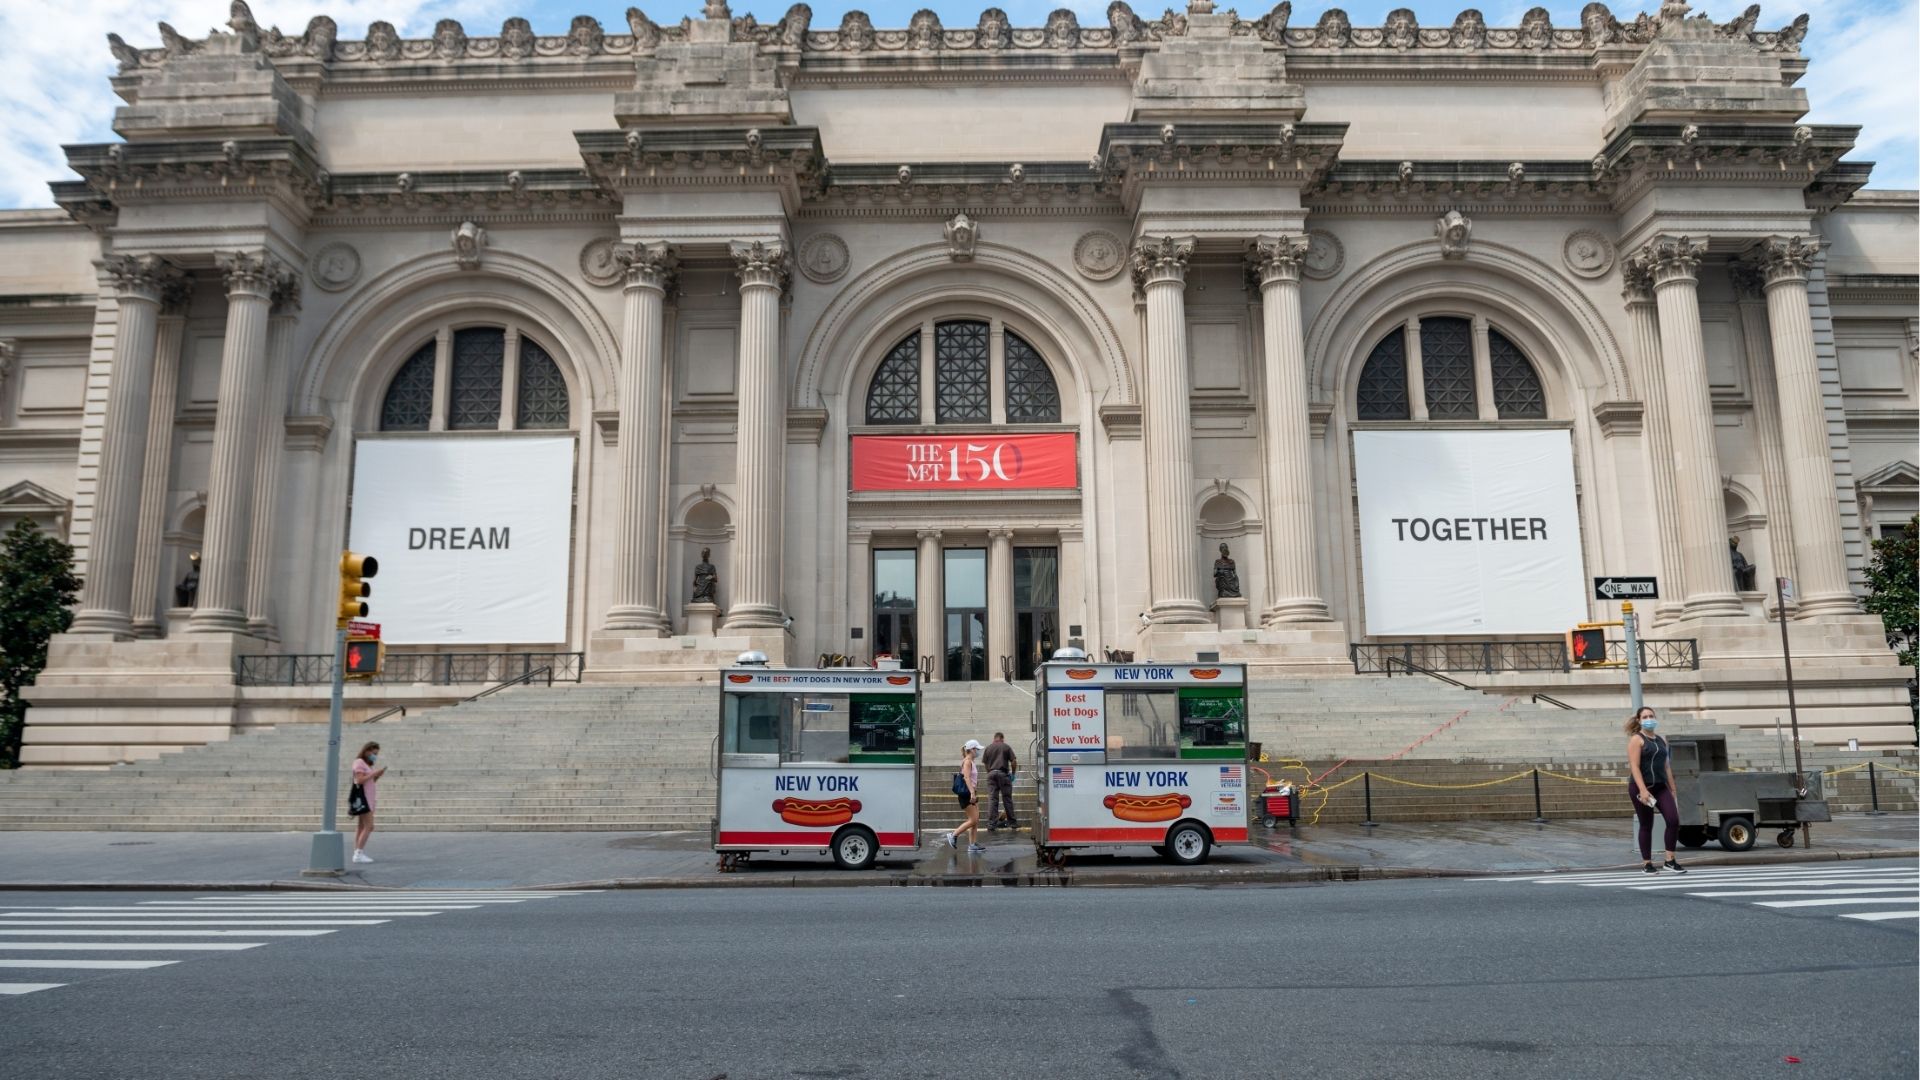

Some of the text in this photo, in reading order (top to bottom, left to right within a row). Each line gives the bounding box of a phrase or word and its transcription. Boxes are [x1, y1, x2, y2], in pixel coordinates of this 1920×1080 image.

[906, 443, 943, 462] THE
[947, 443, 1022, 481] 150
[906, 464, 944, 482] MET
[1392, 517, 1548, 542] TOGETHER
[408, 527, 510, 550] DREAM
[1604, 583, 1650, 593] ONE WAY
[1115, 667, 1174, 680] NEW YORK
[1065, 694, 1086, 703] Best
[1053, 707, 1098, 718] Hot Dogs
[1071, 720, 1081, 730] in
[1052, 734, 1101, 744] New York
[775, 775, 859, 791] NEW YORK
[1105, 771, 1188, 787] NEW YORK
